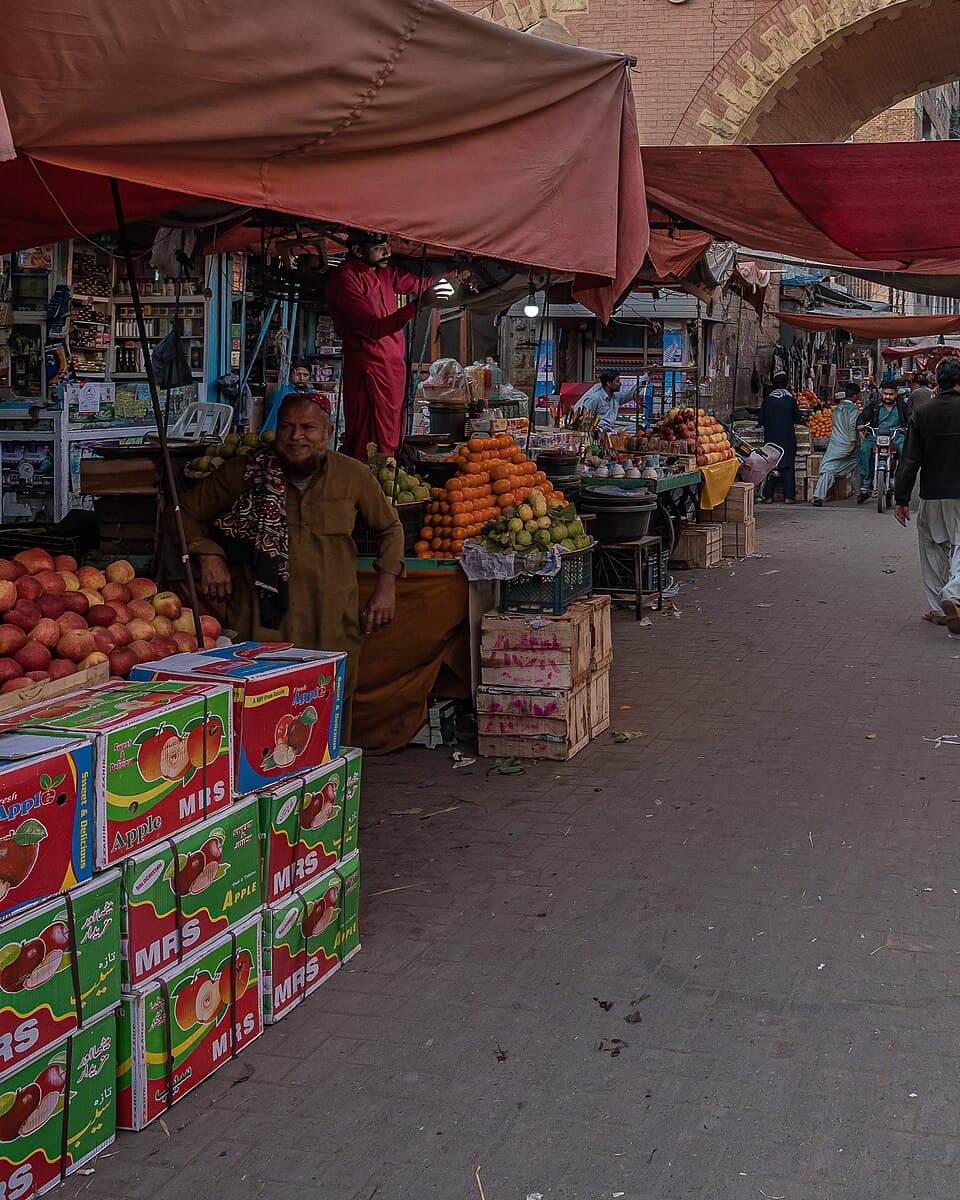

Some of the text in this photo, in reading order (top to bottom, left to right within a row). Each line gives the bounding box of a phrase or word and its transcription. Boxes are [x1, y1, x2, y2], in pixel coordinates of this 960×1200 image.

[292, 686, 327, 706] Apple
[80, 771, 89, 805] Sweet
[179, 780, 226, 820] MRS
[79, 819, 89, 870] Delicious
[111, 814, 162, 853] Apple
[135, 861, 163, 892] BALOCHISTAN
[222, 881, 257, 912] APPLE
[135, 918, 201, 977] MRS
[273, 956, 320, 1008] MRS
[211, 1012, 255, 1062] MRS
